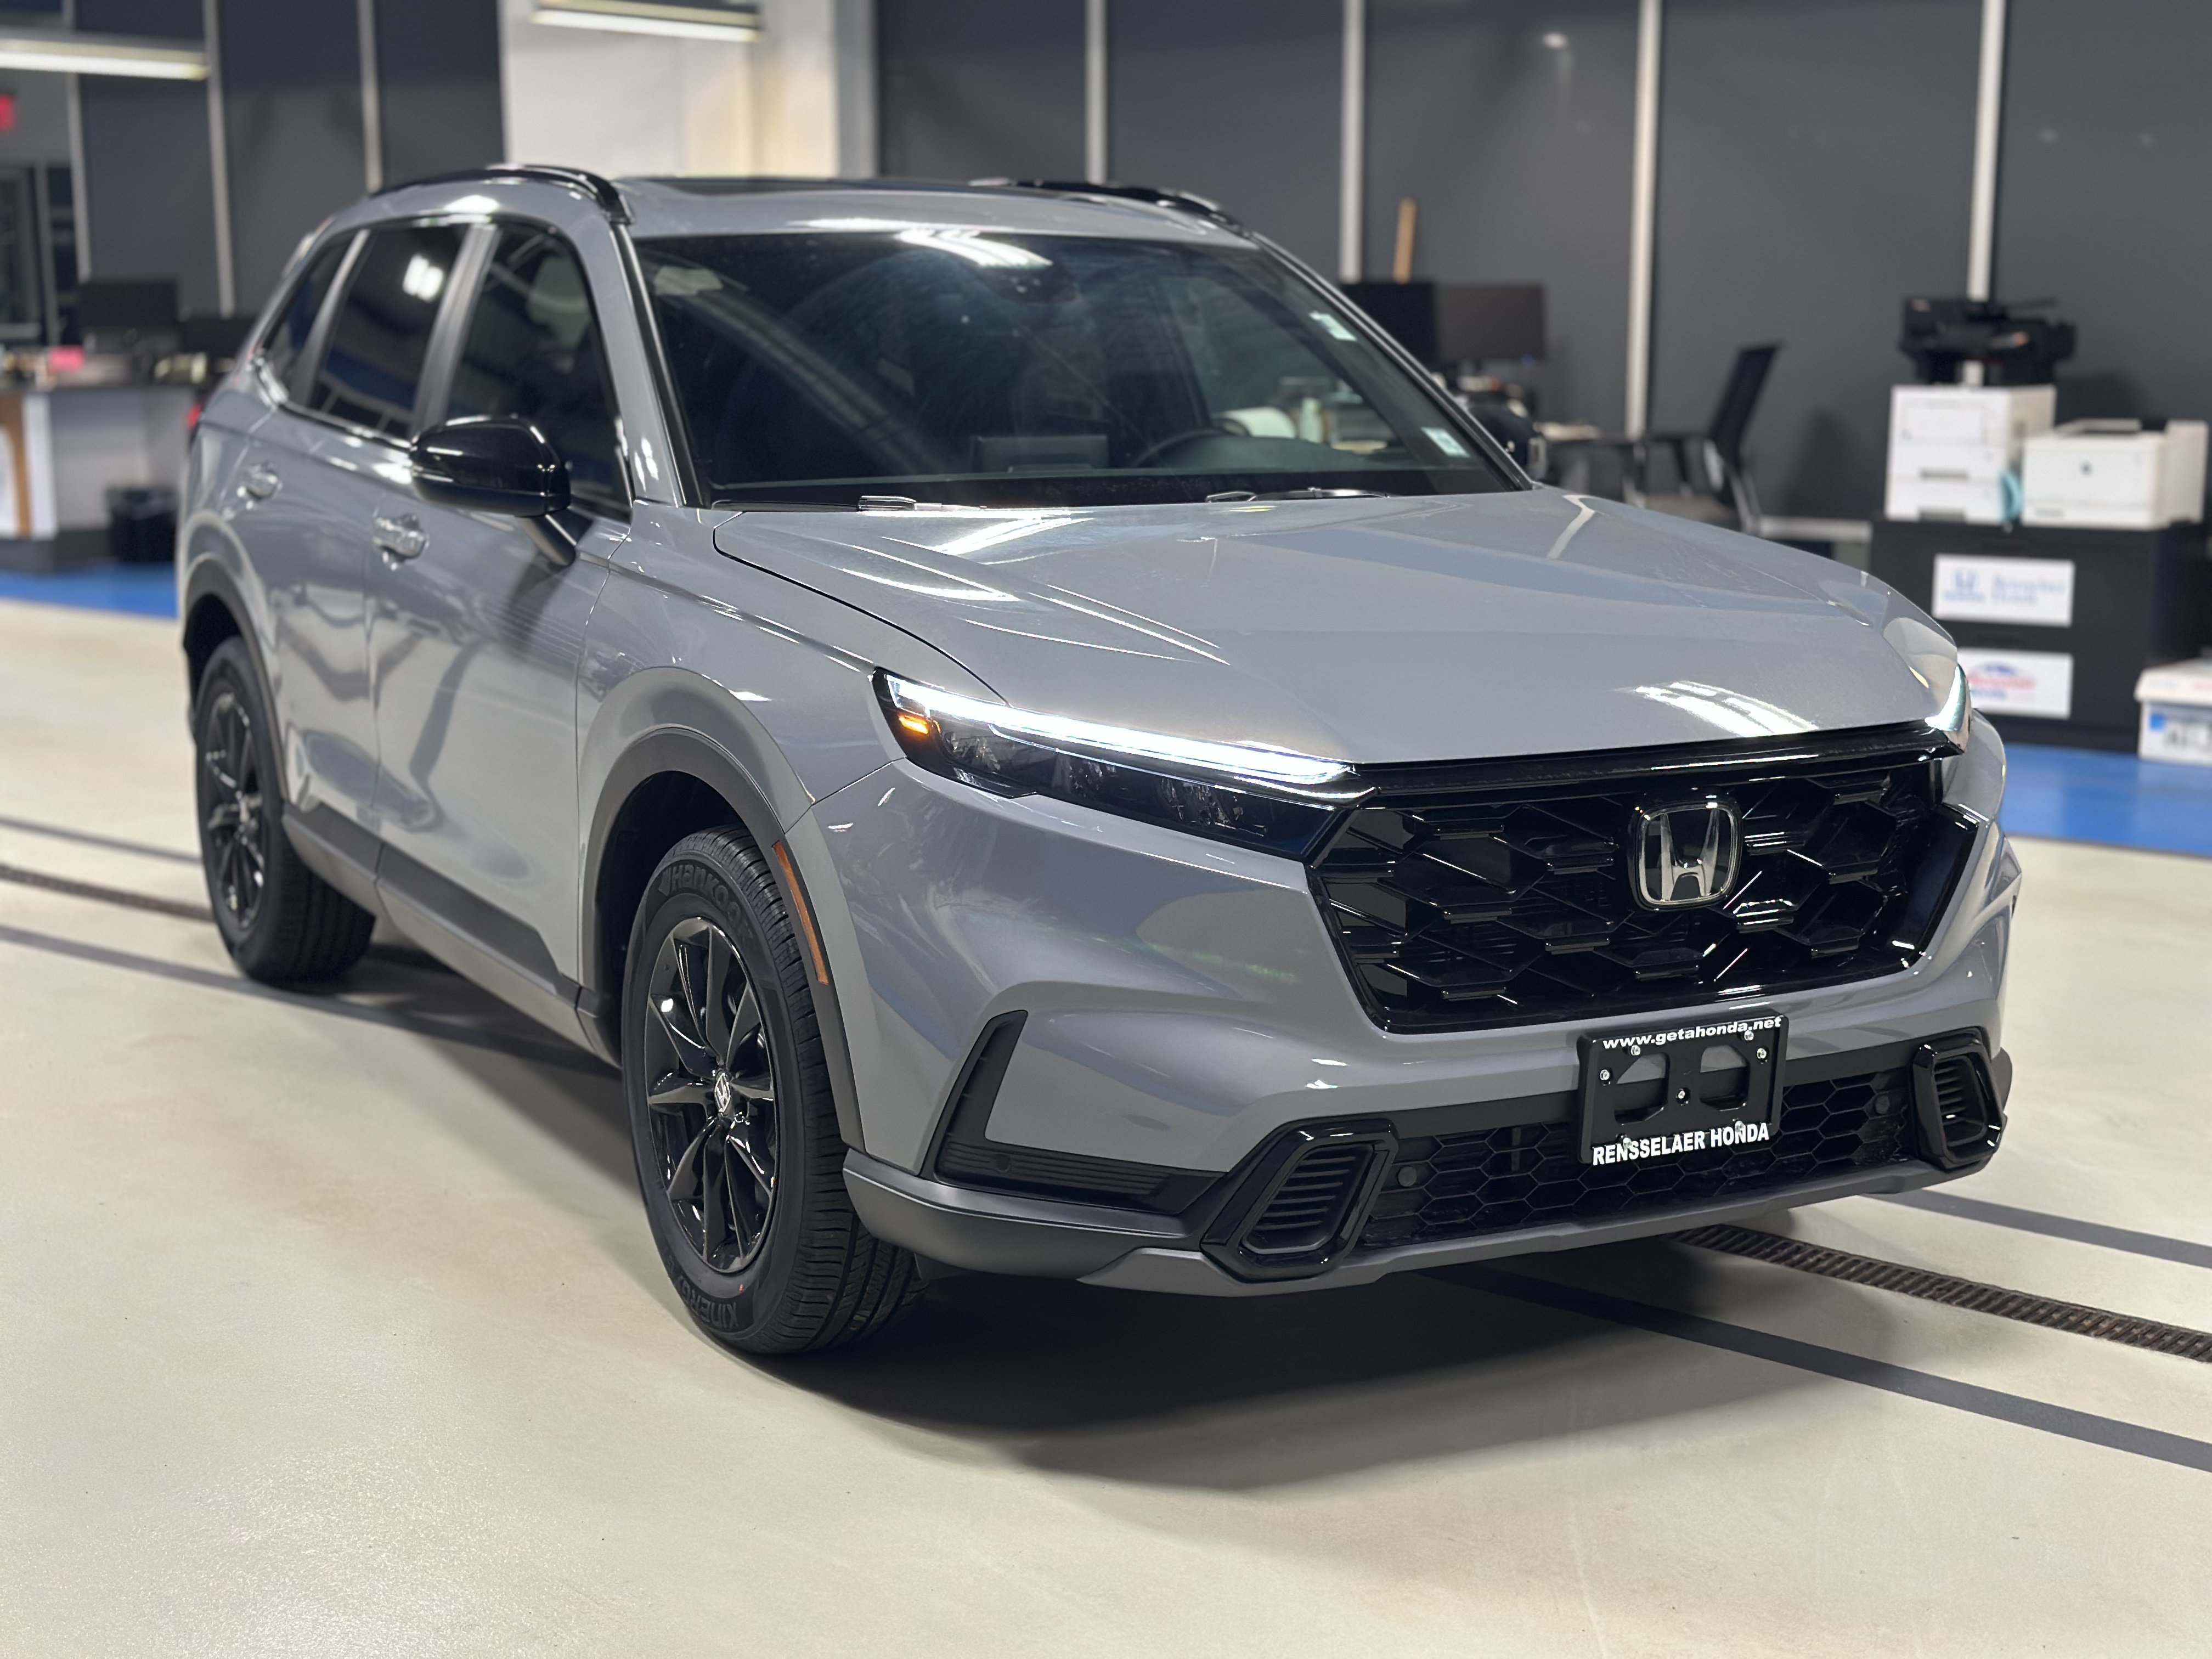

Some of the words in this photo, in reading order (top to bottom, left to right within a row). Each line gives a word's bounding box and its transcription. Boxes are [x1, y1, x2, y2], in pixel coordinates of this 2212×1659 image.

[1602, 1016, 1781, 1049] www.getahonda.net
[1592, 1130, 1706, 1166] RENSSELAER
[1710, 1122, 1770, 1147] HONDA
